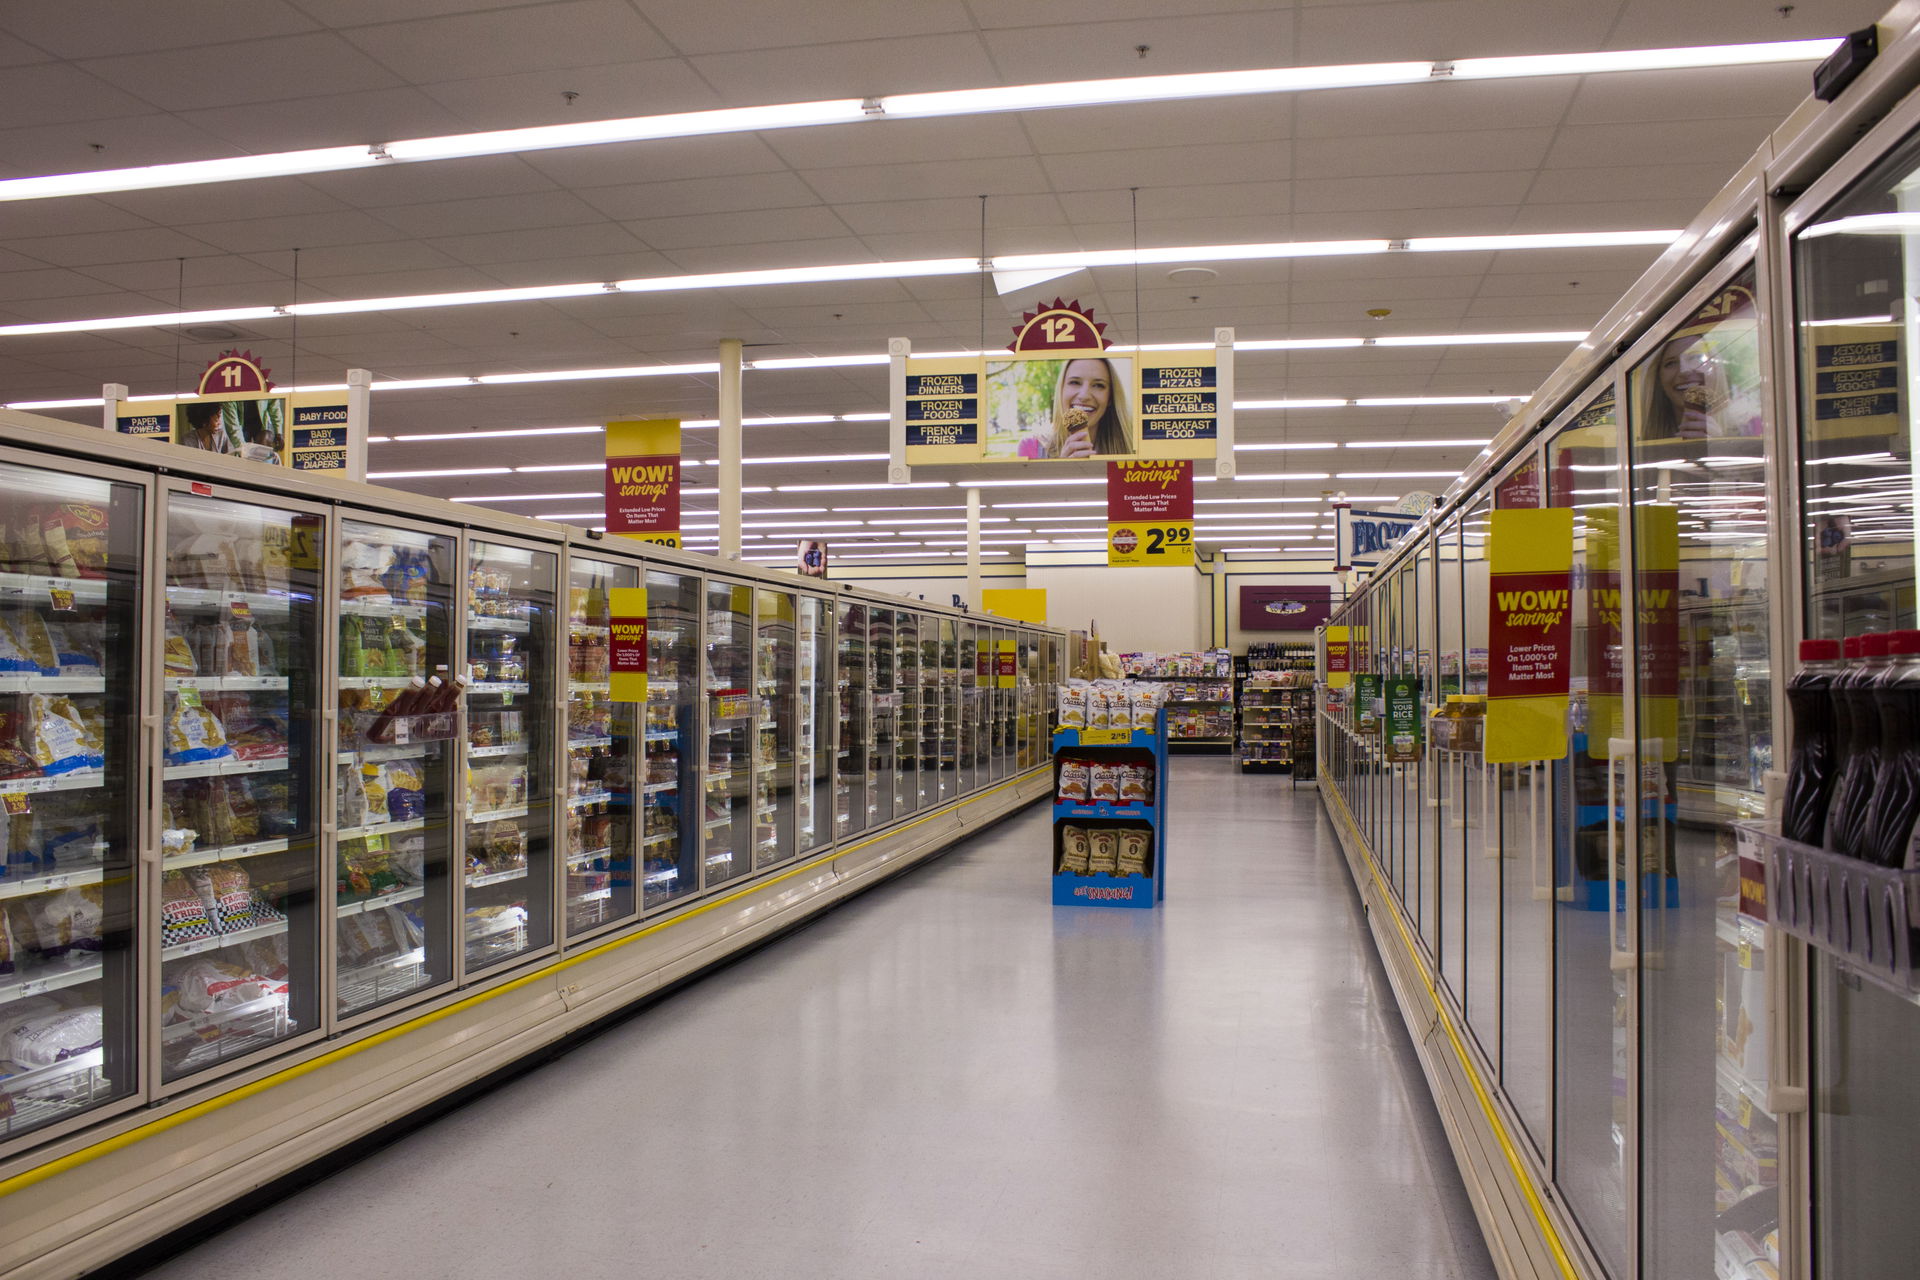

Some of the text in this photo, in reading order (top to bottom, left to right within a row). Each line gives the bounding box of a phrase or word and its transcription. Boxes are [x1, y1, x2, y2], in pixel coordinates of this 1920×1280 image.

[1041, 318, 1075, 343] 12
[221, 365, 242, 388] 11
[1159, 368, 1202, 378] FROZEN
[920, 376, 962, 386] FROZEN
[1160, 378, 1202, 388] PIZZAS
[918, 385, 964, 395] DINNERS
[1157, 394, 1202, 404] FROZEN
[920, 401, 963, 411] FROZEN
[1145, 403, 1215, 413] VEGETABLES
[300, 410, 347, 422] BABY FOOD
[923, 410, 960, 420] FOODS
[131, 417, 158, 427] PAPER
[1150, 420, 1211, 430] BREAKFAST
[128, 425, 161, 434] TOWELS
[310, 429, 332, 439] BABY
[920, 426, 963, 436] FRENCH
[1165, 430, 1196, 438] FOOD
[308, 437, 336, 447] NEEDS
[926, 435, 956, 445] FRIES
[296, 450, 347, 462] DISPOSABLE
[303, 460, 339, 469] DIAPERS
[612, 465, 674, 484] WOW!
[1123, 468, 1180, 489] savings
[619, 483, 669, 503] savings
[1496, 589, 1569, 611] WOW!
[1505, 610, 1563, 634] savings
[611, 625, 644, 634] WOW!
[615, 634, 642, 645] savings
[1509, 644, 1556, 653] Lower Prices
[1507, 652, 1558, 662] On 1,000's Of
[1512, 662, 1552, 672] Items That
[1508, 671, 1556, 681] Matter Most
[1392, 710, 1414, 719] RICE
[173, 907, 203, 920] FRIES
